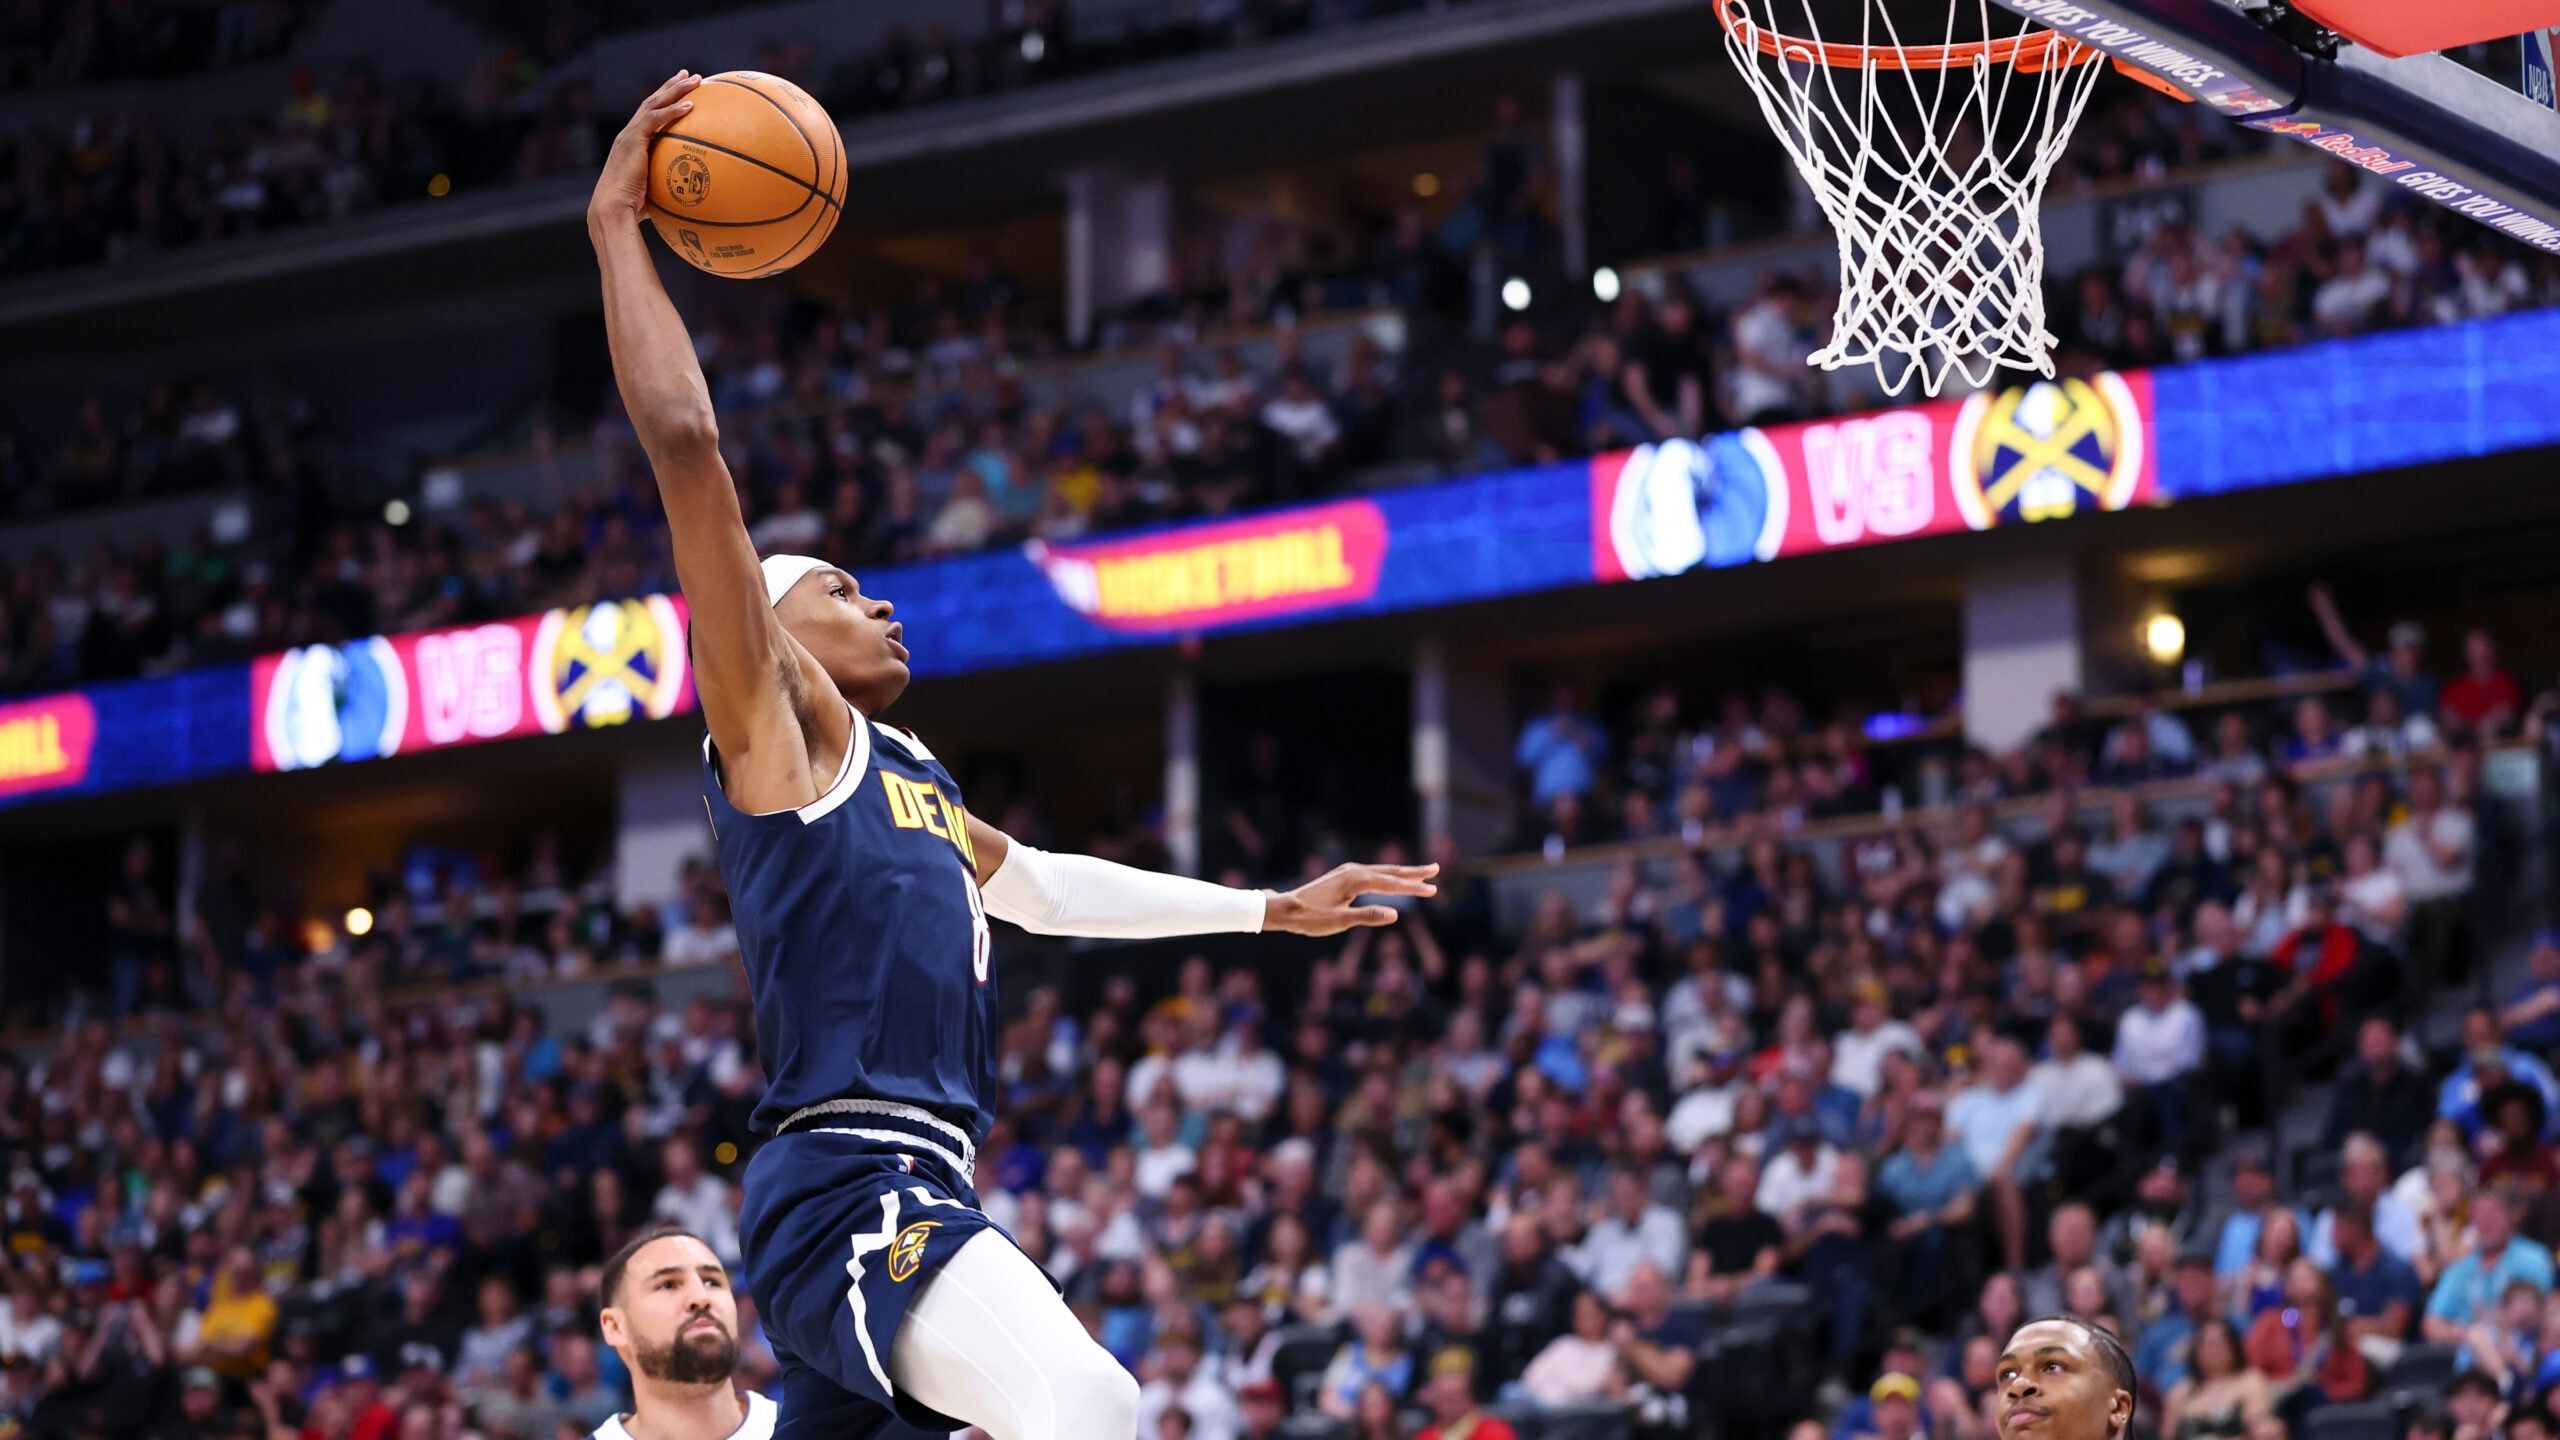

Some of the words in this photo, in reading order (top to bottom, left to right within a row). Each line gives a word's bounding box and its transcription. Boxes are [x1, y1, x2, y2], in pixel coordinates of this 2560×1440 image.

[2075, 20, 2146, 46] YOU
[2529, 64, 2549, 104] NBA
[2397, 171, 2473, 200] GIVES
[2450, 194, 2514, 218] YOU
[1802, 411, 1935, 544] VS
[415, 623, 523, 745] VS
[879, 770, 977, 875] DEN
[961, 865, 990, 984] 8
